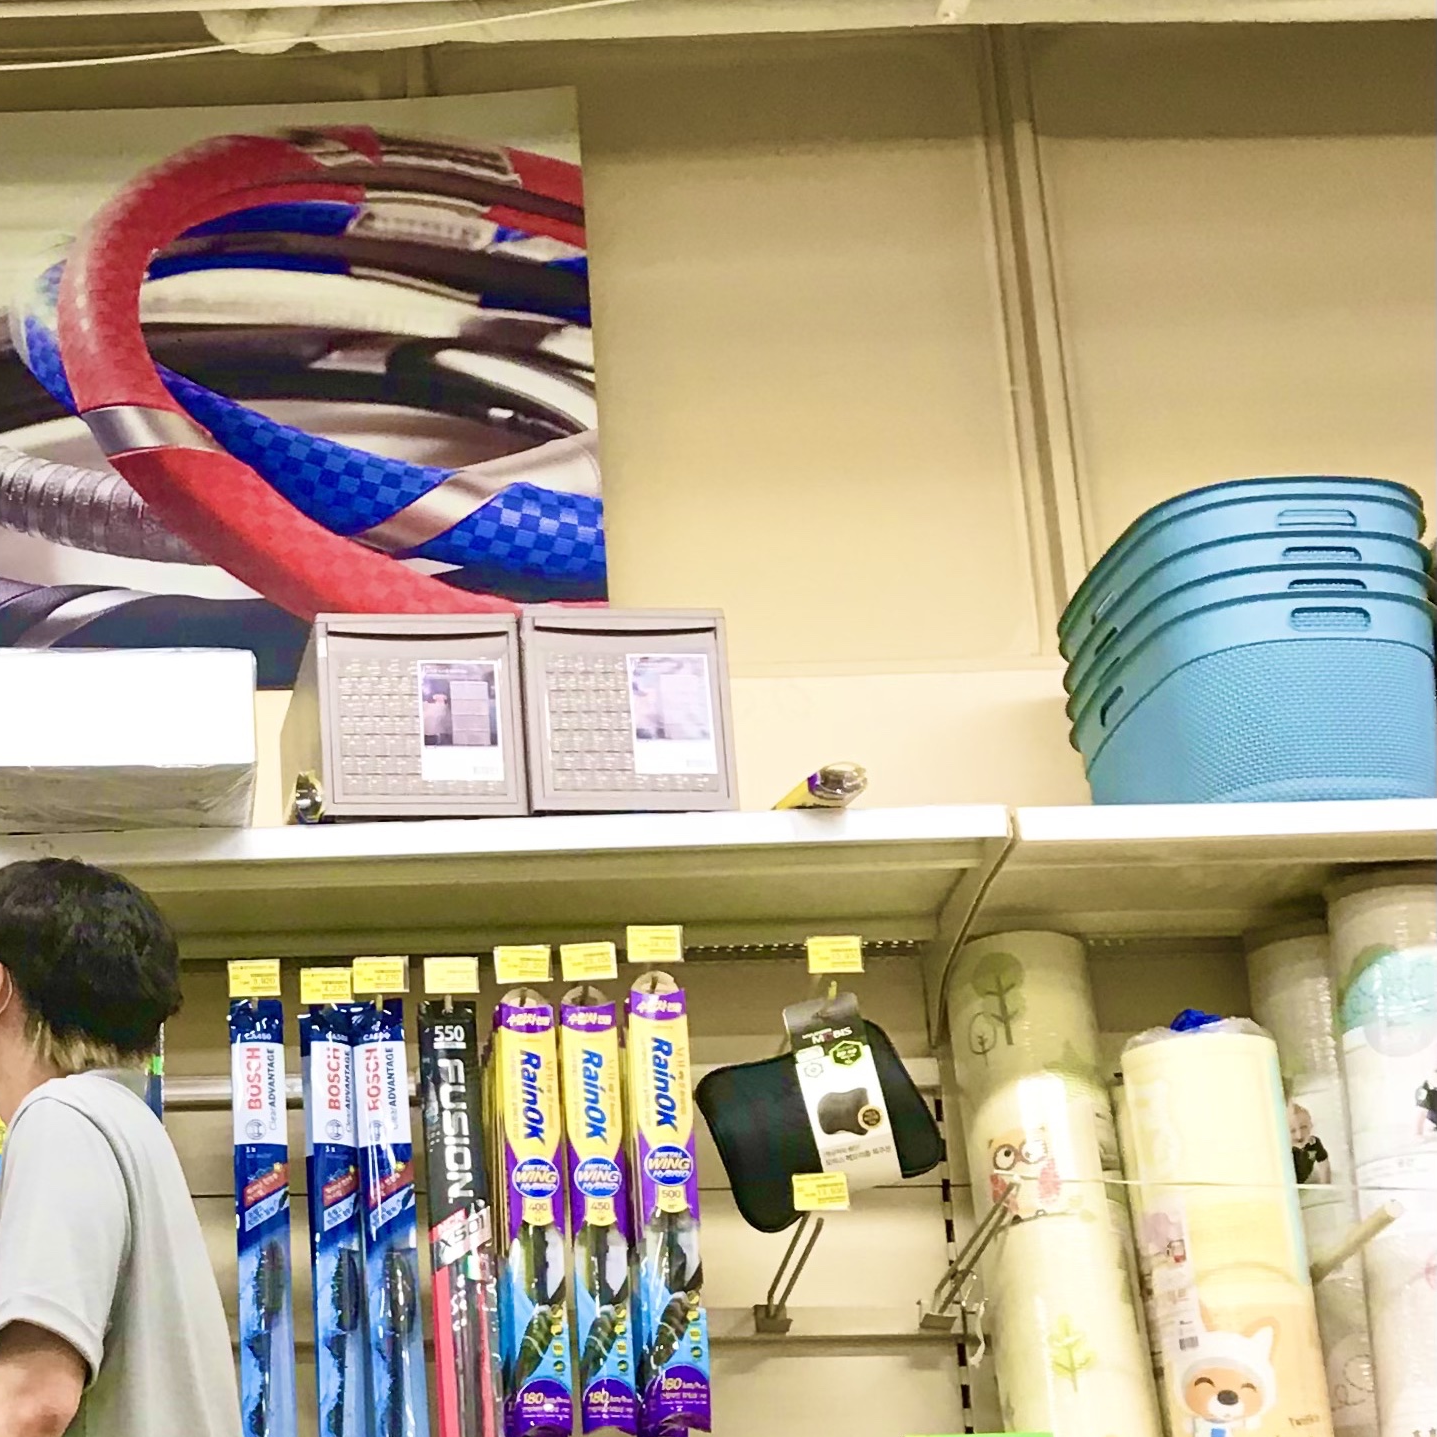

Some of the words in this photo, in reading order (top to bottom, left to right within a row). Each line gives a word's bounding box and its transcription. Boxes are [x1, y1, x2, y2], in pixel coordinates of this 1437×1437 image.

[433, 1025, 465, 1042] 550
[246, 1047, 262, 1112] BOSCH
[327, 1047, 342, 1111] BOSCH
[651, 1036, 678, 1134] RainOK
[520, 1050, 546, 1145] RainOK
[582, 1049, 609, 1146] RainOK
[438, 1058, 475, 1204] FUSION
[647, 1156, 691, 1170] WING
[515, 1170, 557, 1183] WING
[577, 1169, 620, 1183] WING
[661, 1189, 682, 1199] 500
[527, 1202, 549, 1212] 400
[589, 1201, 611, 1212] 450
[661, 1378, 683, 1391] 180
[522, 1392, 544, 1404] 180
